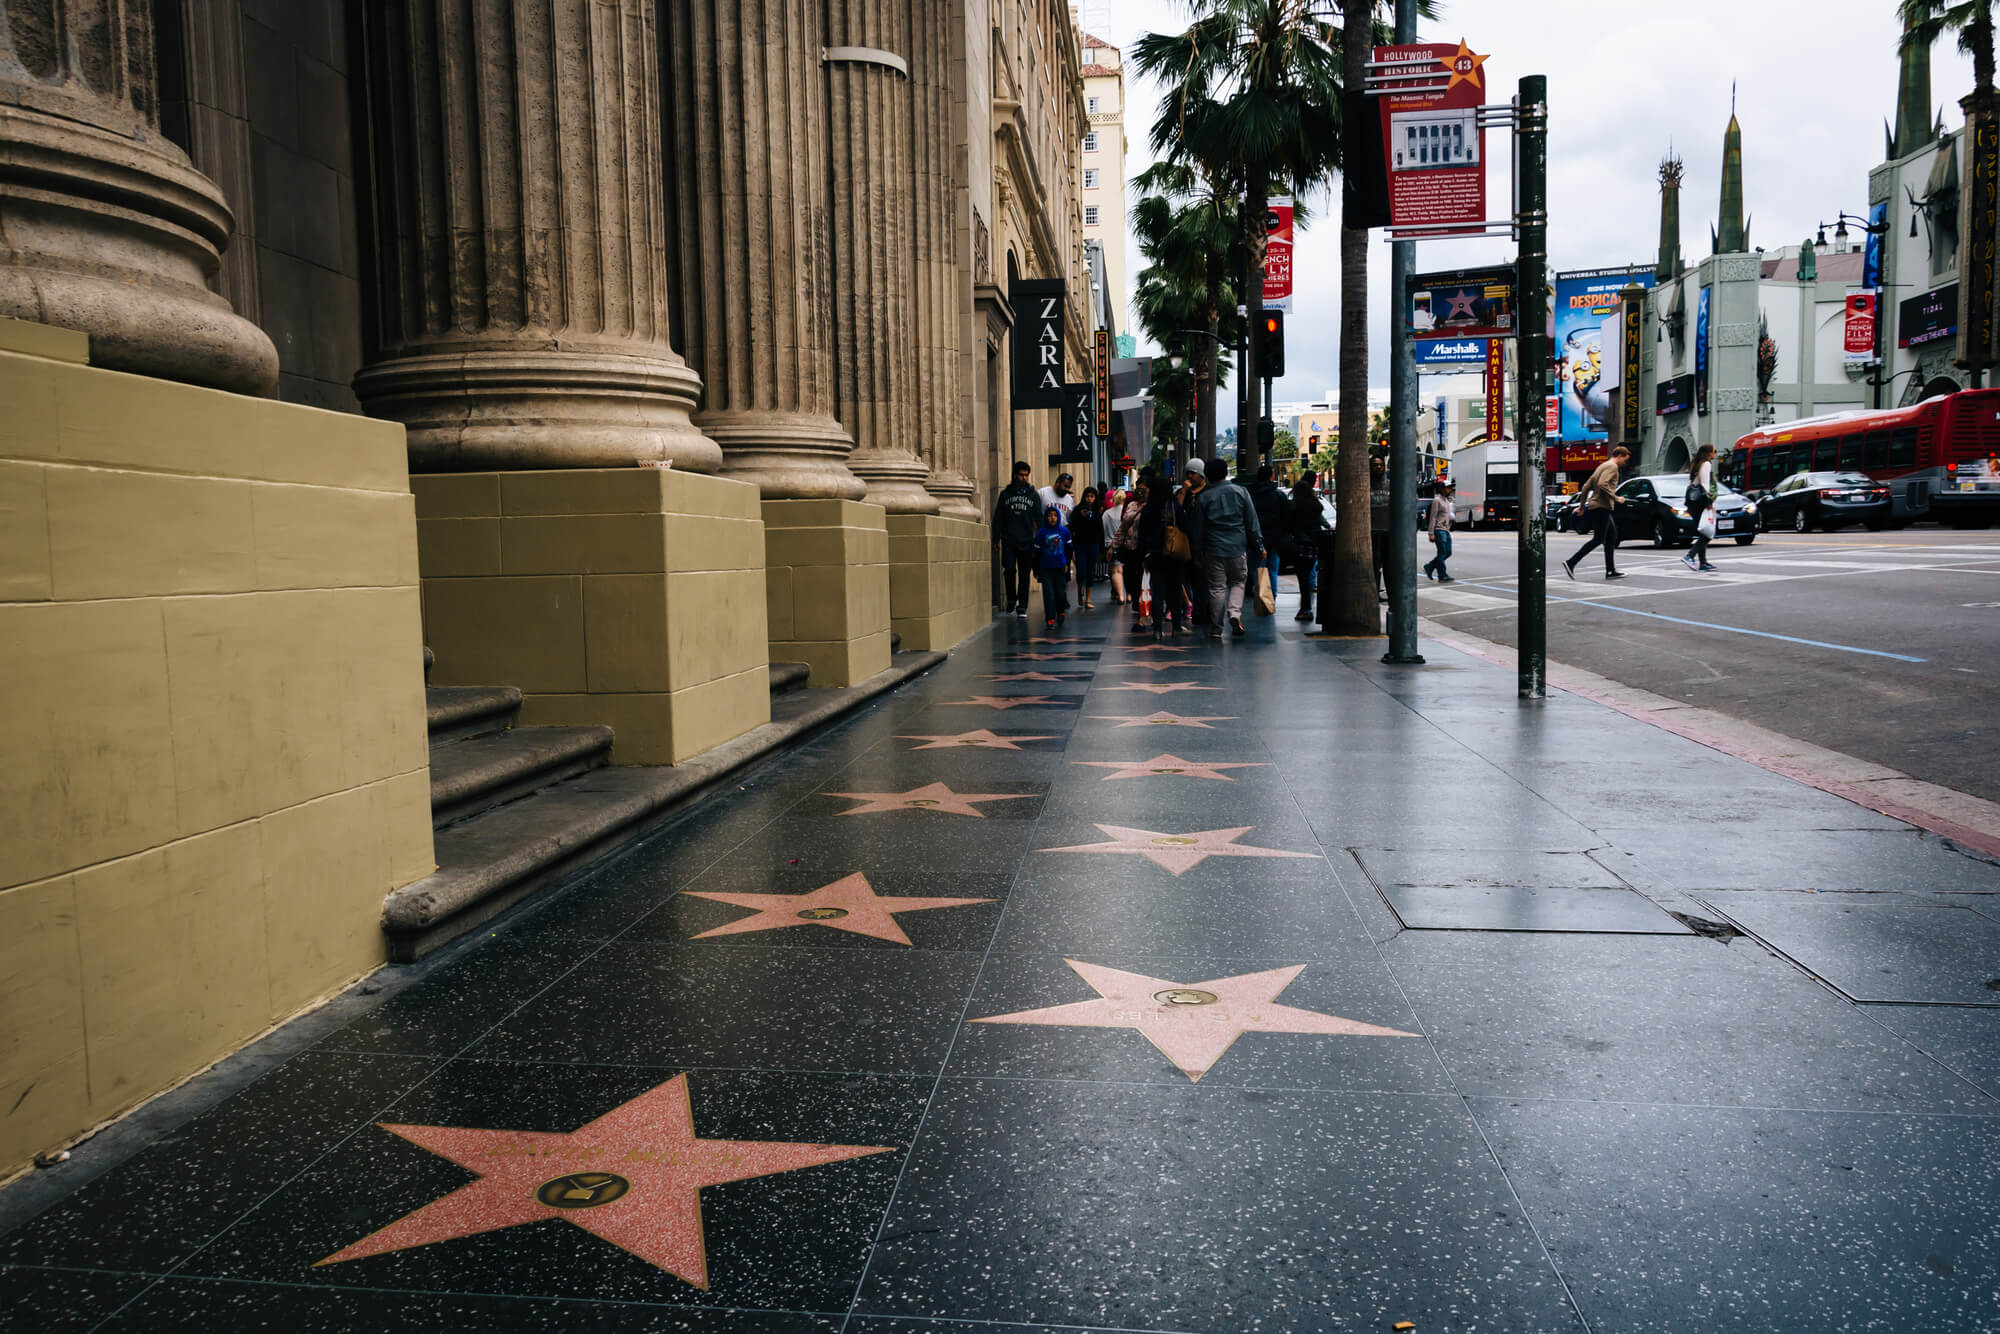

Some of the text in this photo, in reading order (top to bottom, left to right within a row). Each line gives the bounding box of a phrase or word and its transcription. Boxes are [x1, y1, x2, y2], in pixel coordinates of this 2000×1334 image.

[1384, 50, 1432, 61] HOLLYWOOD
[1384, 65, 1432, 76] HISTORIC
[1455, 59, 1472, 70] 43
[1384, 79, 1433, 88] SITE
[1401, 94, 1424, 102] Masonic
[1425, 93, 1445, 101] Temple
[1264, 255, 1289, 263] ENCH
[1569, 293, 1622, 309] DESPICA
[1922, 303, 1943, 315] TIDAL
[1698, 298, 1707, 370] IMAX
[1038, 298, 1060, 389] ZARA
[1432, 342, 1479, 354] Marshalls
[1627, 312, 1640, 428] CHINESE
[1491, 339, 1500, 440] DAME TUSSAUD
[1076, 394, 1089, 451] ZARA
